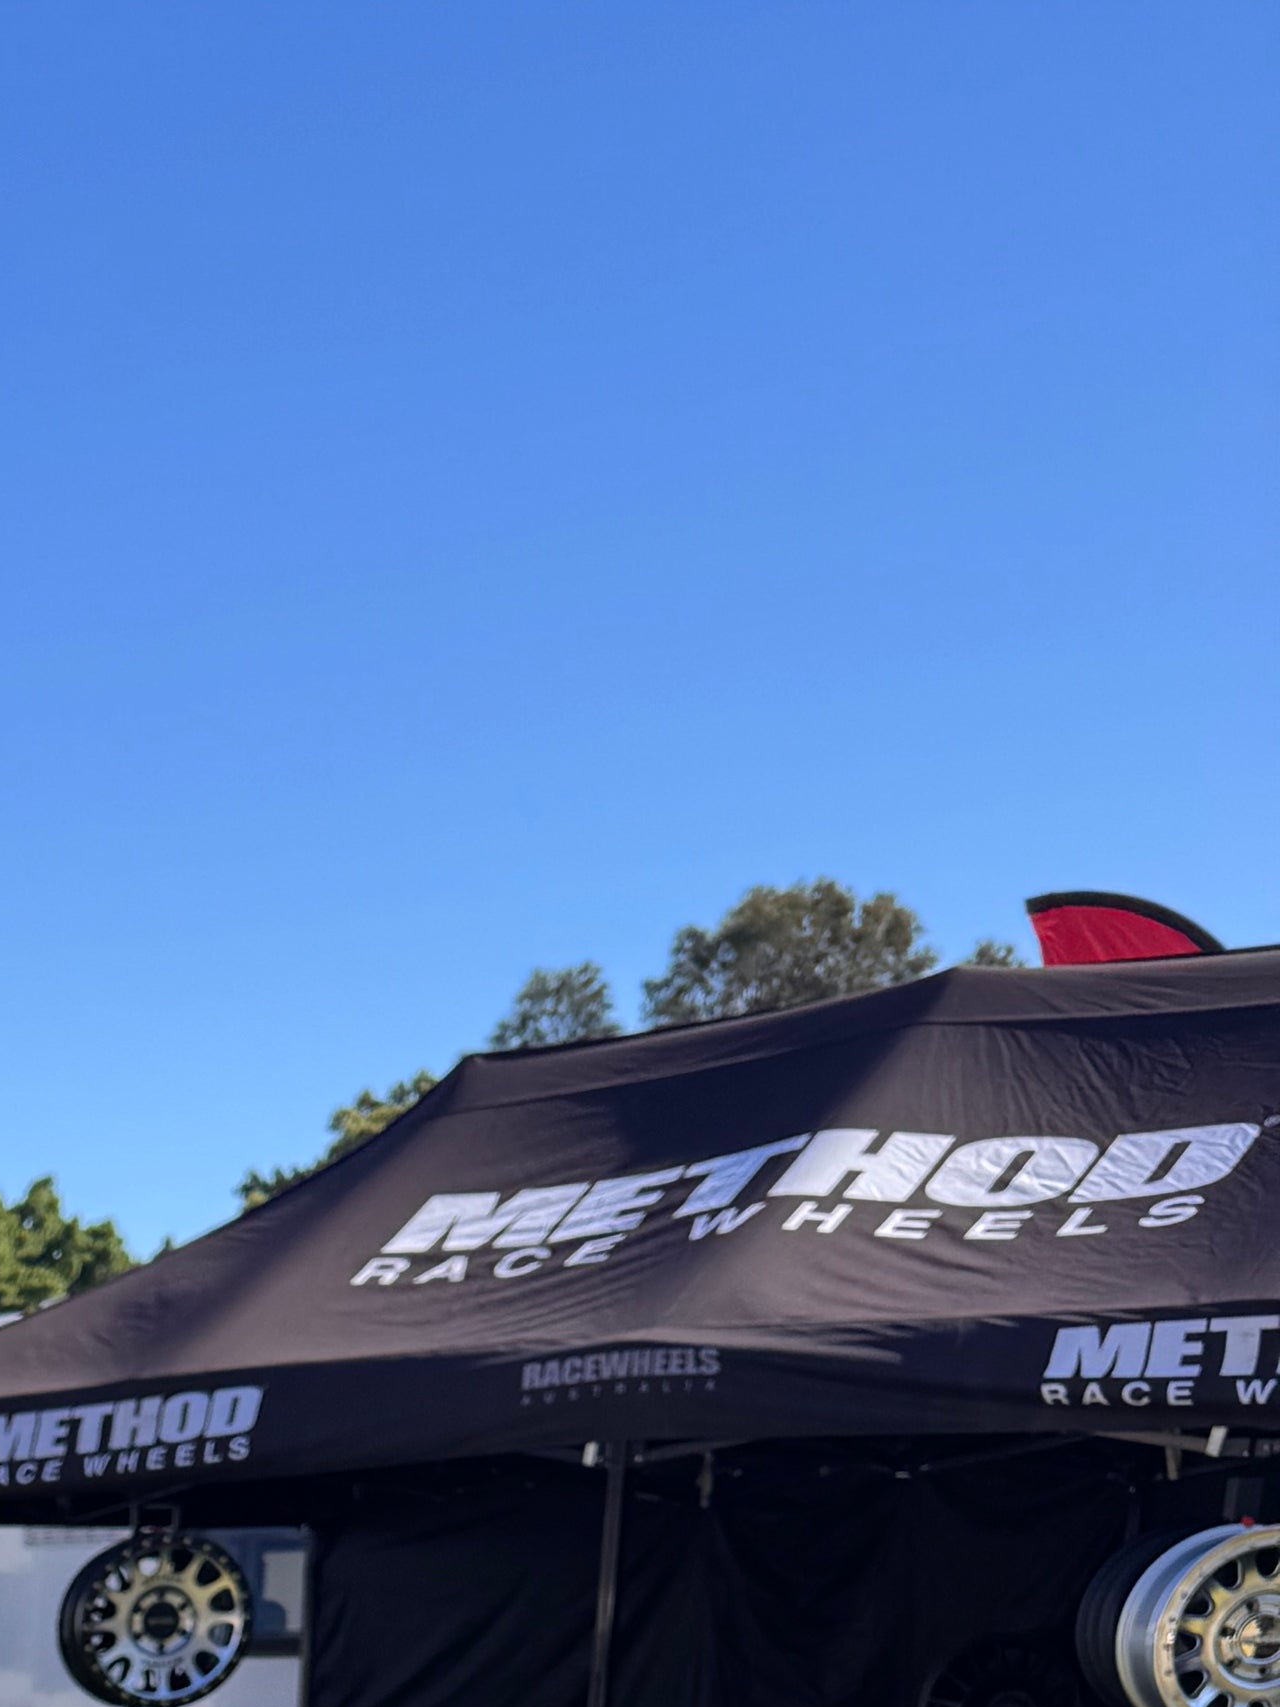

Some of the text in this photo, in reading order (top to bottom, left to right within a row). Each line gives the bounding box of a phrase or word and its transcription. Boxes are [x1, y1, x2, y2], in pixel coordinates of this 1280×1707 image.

[380, 1122, 1261, 1255] METHOD
[349, 1195, 1206, 1287] RACE WHEELS
[1043, 1314, 1280, 1379] MET
[1040, 1380, 1196, 1406] RACE
[83, 1436, 251, 1477] WHEELS
